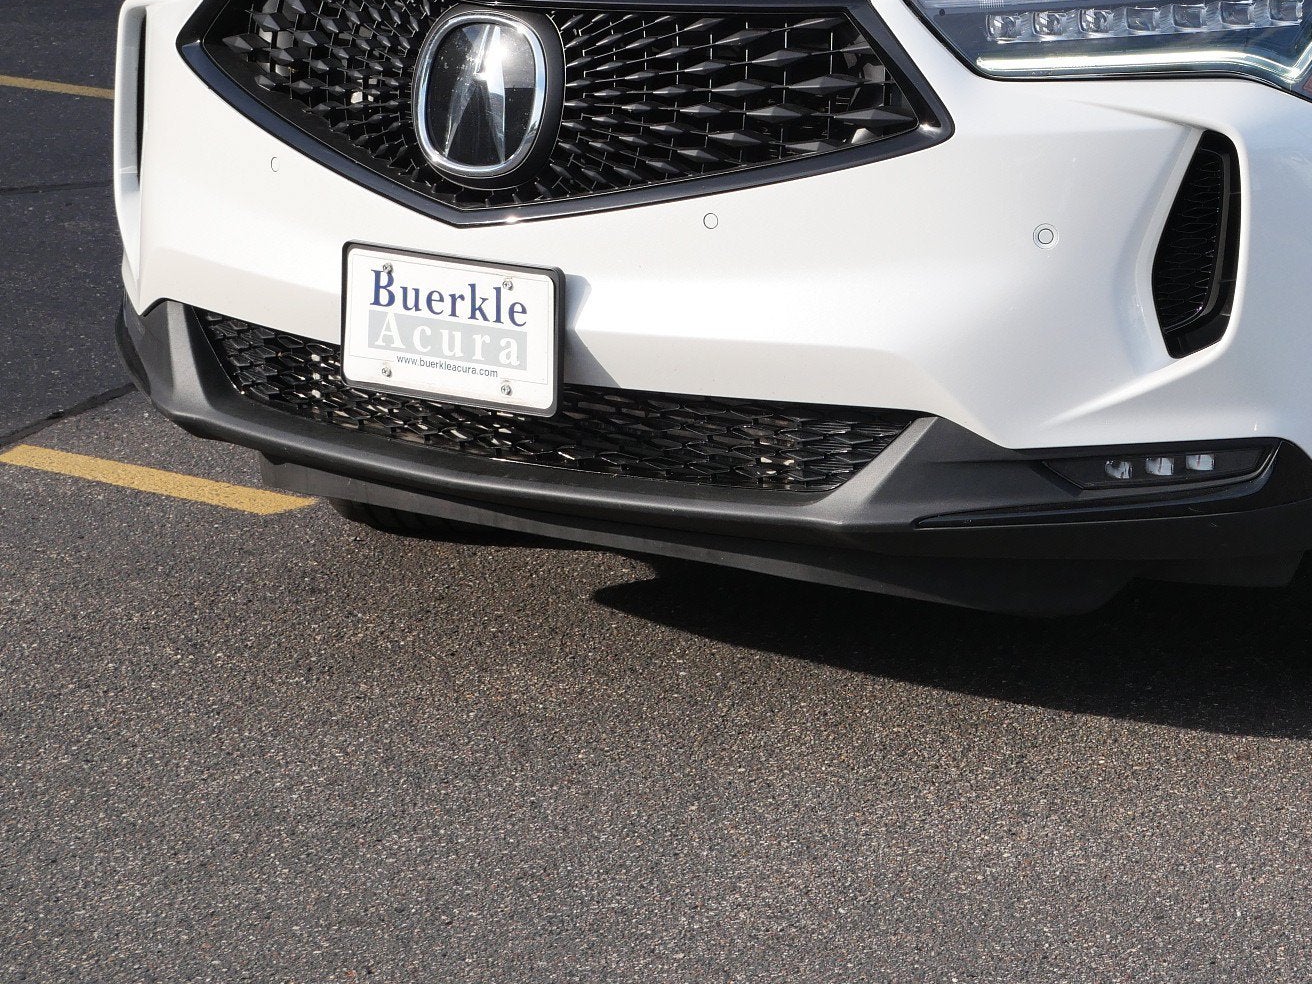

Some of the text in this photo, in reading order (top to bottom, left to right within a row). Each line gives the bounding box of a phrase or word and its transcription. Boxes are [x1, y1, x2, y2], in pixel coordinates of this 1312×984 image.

[369, 268, 528, 328] Buerkle
[374, 312, 521, 367] Acura
[396, 354, 499, 378] www.buerkleacura.com
